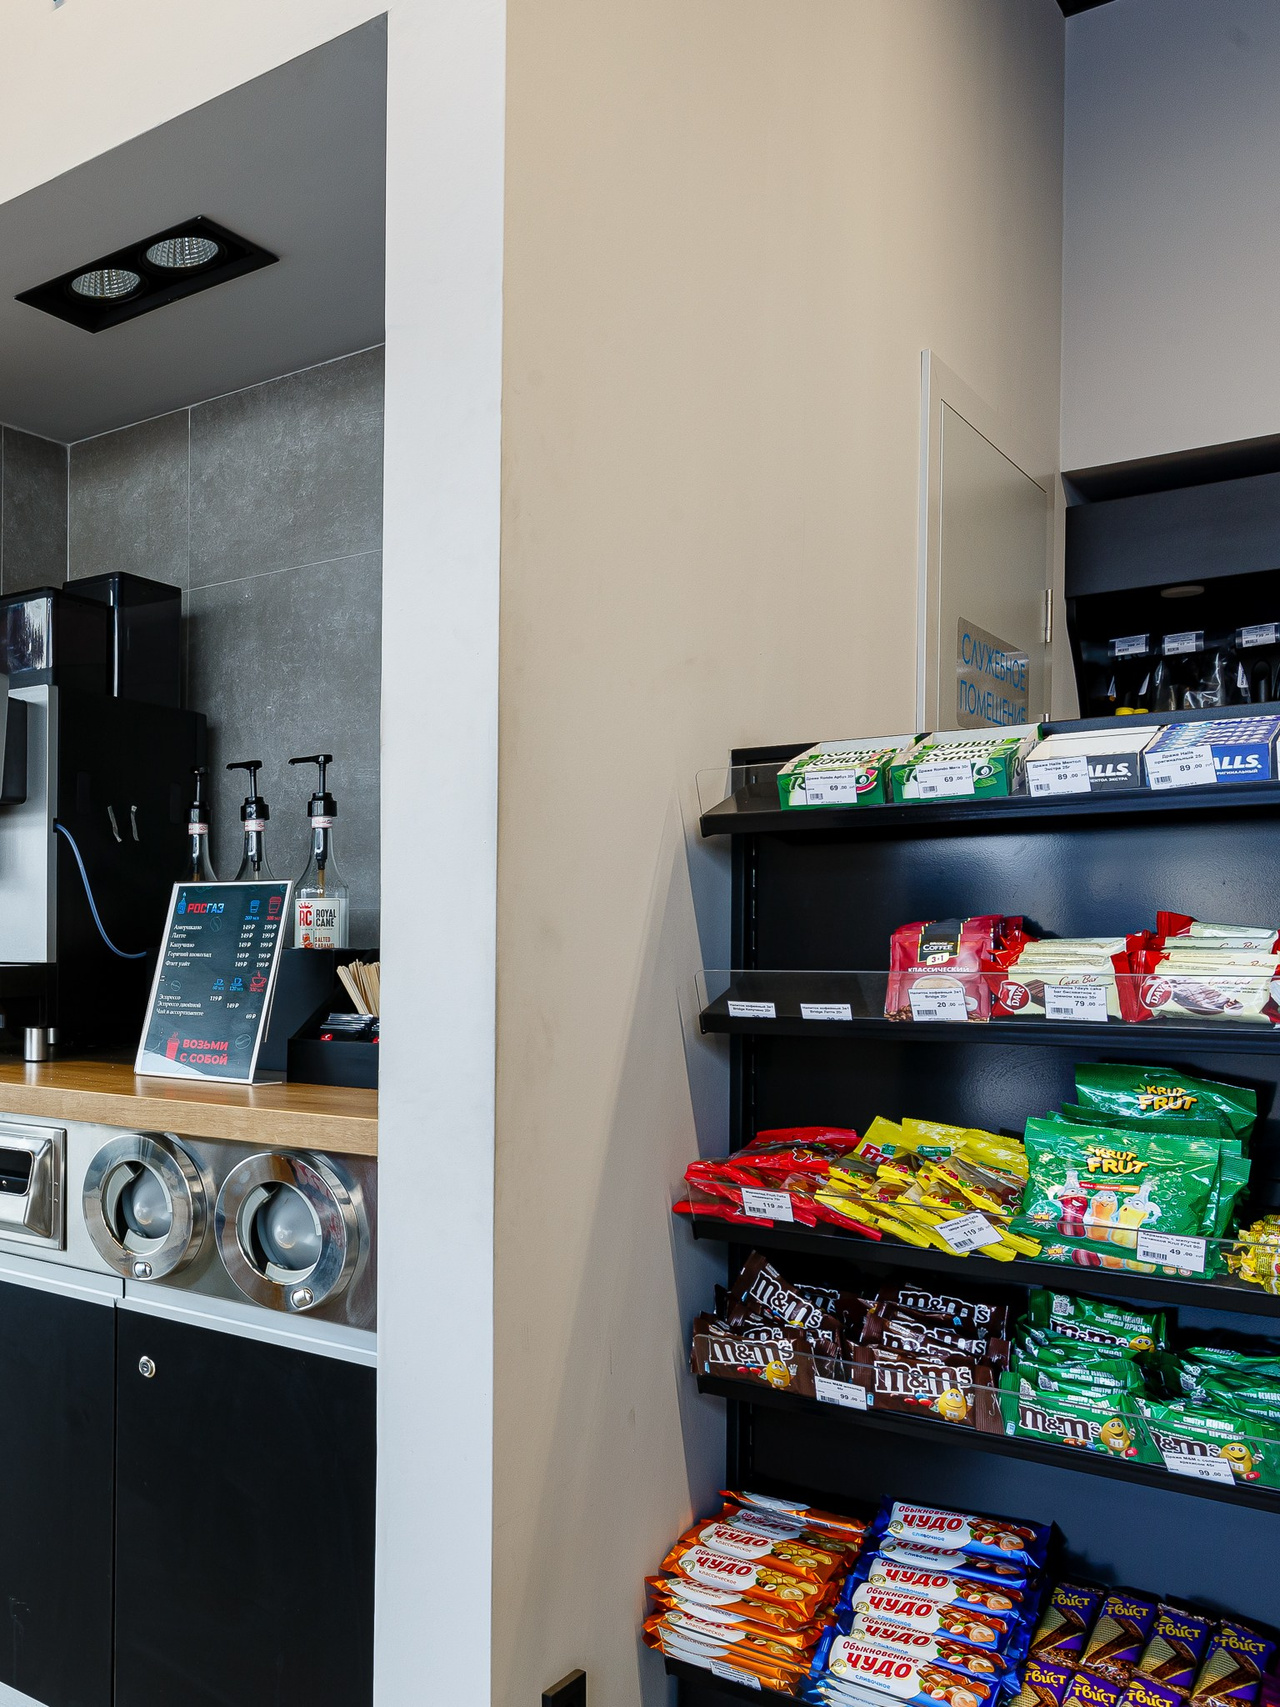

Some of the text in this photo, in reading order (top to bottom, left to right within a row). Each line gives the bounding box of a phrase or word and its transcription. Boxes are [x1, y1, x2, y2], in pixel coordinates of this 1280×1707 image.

[961, 633, 1026, 692] СЛУЖЕБНОЕ
[960, 679, 1027, 726] ПОМЕЩЕНИЕ
[1057, 772, 1068, 781] 89
[1179, 764, 1191, 772] 89
[944, 775, 954, 783] 69
[187, 903, 225, 914] РОСГАЗ
[299, 909, 337, 927] RC ROYAL
[316, 918, 335, 927] CANE
[922, 943, 954, 951] COFFEE
[907, 965, 970, 973] КЛАССИЧЕСКИЙ
[1012, 985, 1026, 1008] DAYS
[182, 1039, 229, 1051] ВОЗЬМИ
[179, 1053, 228, 1066] С СОБОЙ
[1146, 1084, 1187, 1098] KRUT
[1138, 1094, 1198, 1111] FRUT
[1086, 1156, 1150, 1175] FRUT
[963, 1228, 977, 1237] 119
[1169, 1248, 1181, 1256] 49
[839, 1392, 849, 1400] 99
[1198, 1469, 1210, 1477] 99
[898, 1504, 969, 1521] Обыкновенное
[902, 1514, 964, 1532] ЧУДО
[714, 1528, 770, 1548] ЧУДО
[912, 1531, 946, 1543] сливочное
[694, 1555, 753, 1577] ЧУДО
[885, 1568, 950, 1588] ЧУДО
[866, 1586, 940, 1606] Обыкновенное
[869, 1596, 933, 1618] ЧУДО
[865, 1624, 931, 1648] ЧУДО
[842, 1640, 920, 1665] Обыкновенное
[846, 1651, 913, 1679] ЧУДО
[855, 1673, 891, 1690] сливочное
